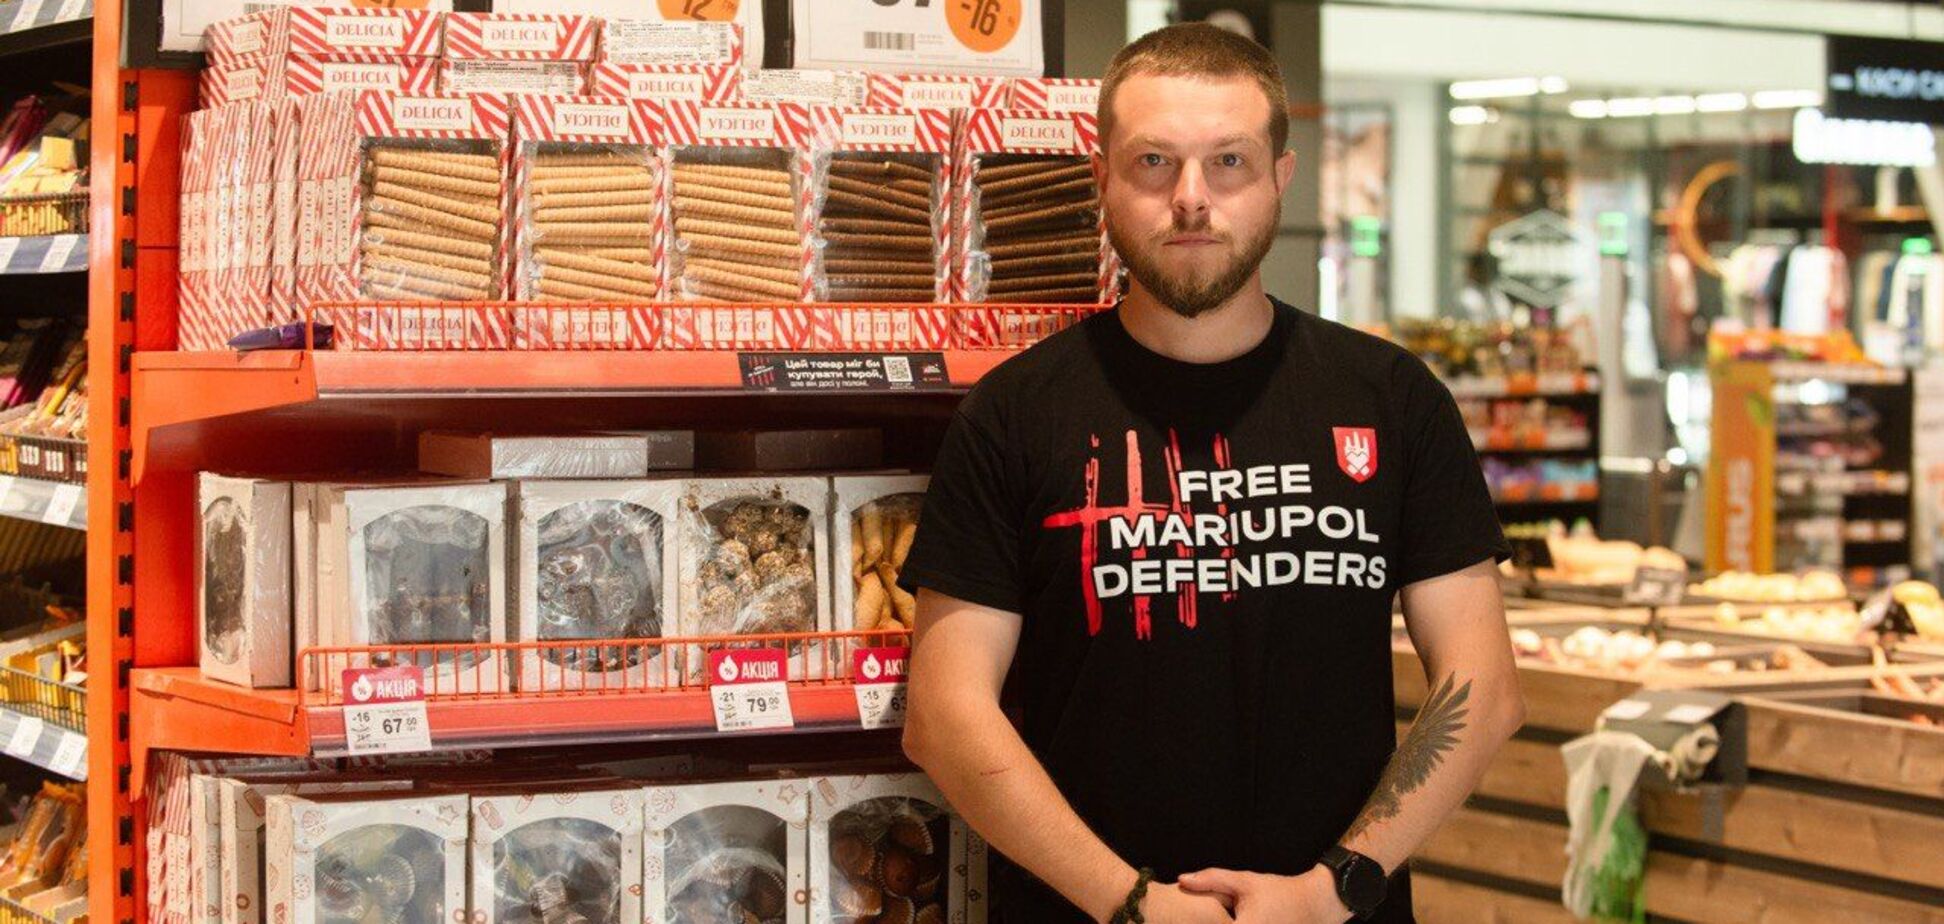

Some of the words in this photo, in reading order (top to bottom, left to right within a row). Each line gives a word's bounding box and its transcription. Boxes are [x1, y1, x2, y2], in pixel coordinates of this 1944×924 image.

[335, 23, 395, 37] DELICIA
[491, 26, 548, 41] DELICIA
[332, 70, 391, 84] DELICIA
[638, 82, 695, 94] DELICIA
[402, 106, 462, 120] DELICIA
[785, 359, 808, 370] Цей
[810, 361, 844, 370] товар
[845, 359, 863, 368] міг
[865, 359, 881, 368] би
[788, 371, 844, 380] купувати
[1178, 464, 1312, 502] FREE
[1109, 505, 1380, 549] MARIUPOL
[1092, 550, 1387, 598] DEFENDERS
[741, 661, 779, 680] АКЦІЯ
[376, 679, 416, 699] АКЦІЯ
[720, 692, 735, 702] -21
[747, 697, 767, 713] 79
[352, 712, 370, 722] -16
[382, 718, 402, 734] 67
